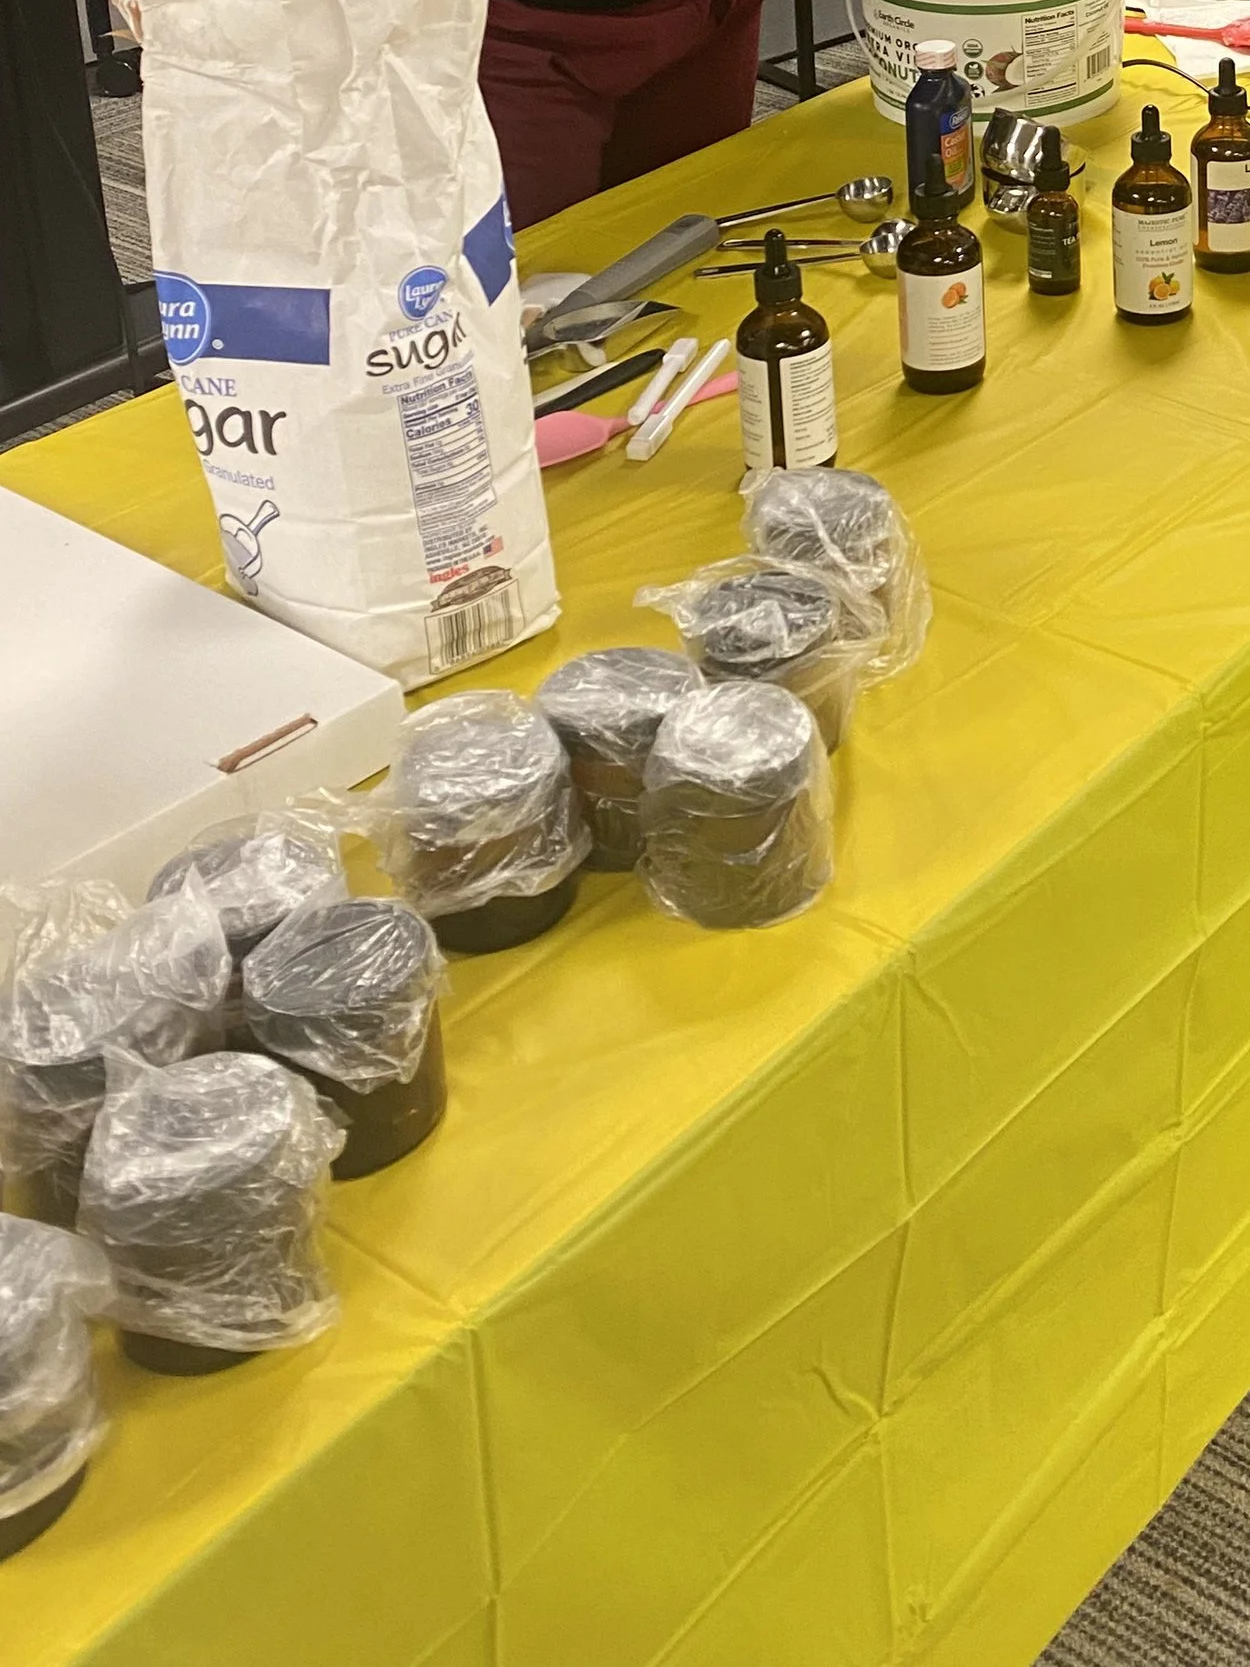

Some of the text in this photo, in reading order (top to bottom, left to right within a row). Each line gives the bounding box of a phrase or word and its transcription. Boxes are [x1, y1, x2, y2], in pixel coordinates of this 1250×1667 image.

[894, 17, 915, 29] Circle
[1025, 10, 1075, 24] Nutrition Facts
[1150, 238, 1178, 247] Lemon
[158, 300, 196, 318] ura
[161, 321, 200, 341] ynn
[388, 309, 454, 343] PURE CAN
[180, 374, 238, 398] CANE
[382, 381, 410, 395] Extra
[413, 372, 434, 387] Fine
[401, 382, 447, 405] Nutrition
[184, 398, 288, 457] gar
[406, 398, 479, 438] Calories 30
[203, 459, 276, 492] Granulated
[430, 563, 470, 585] ingles
